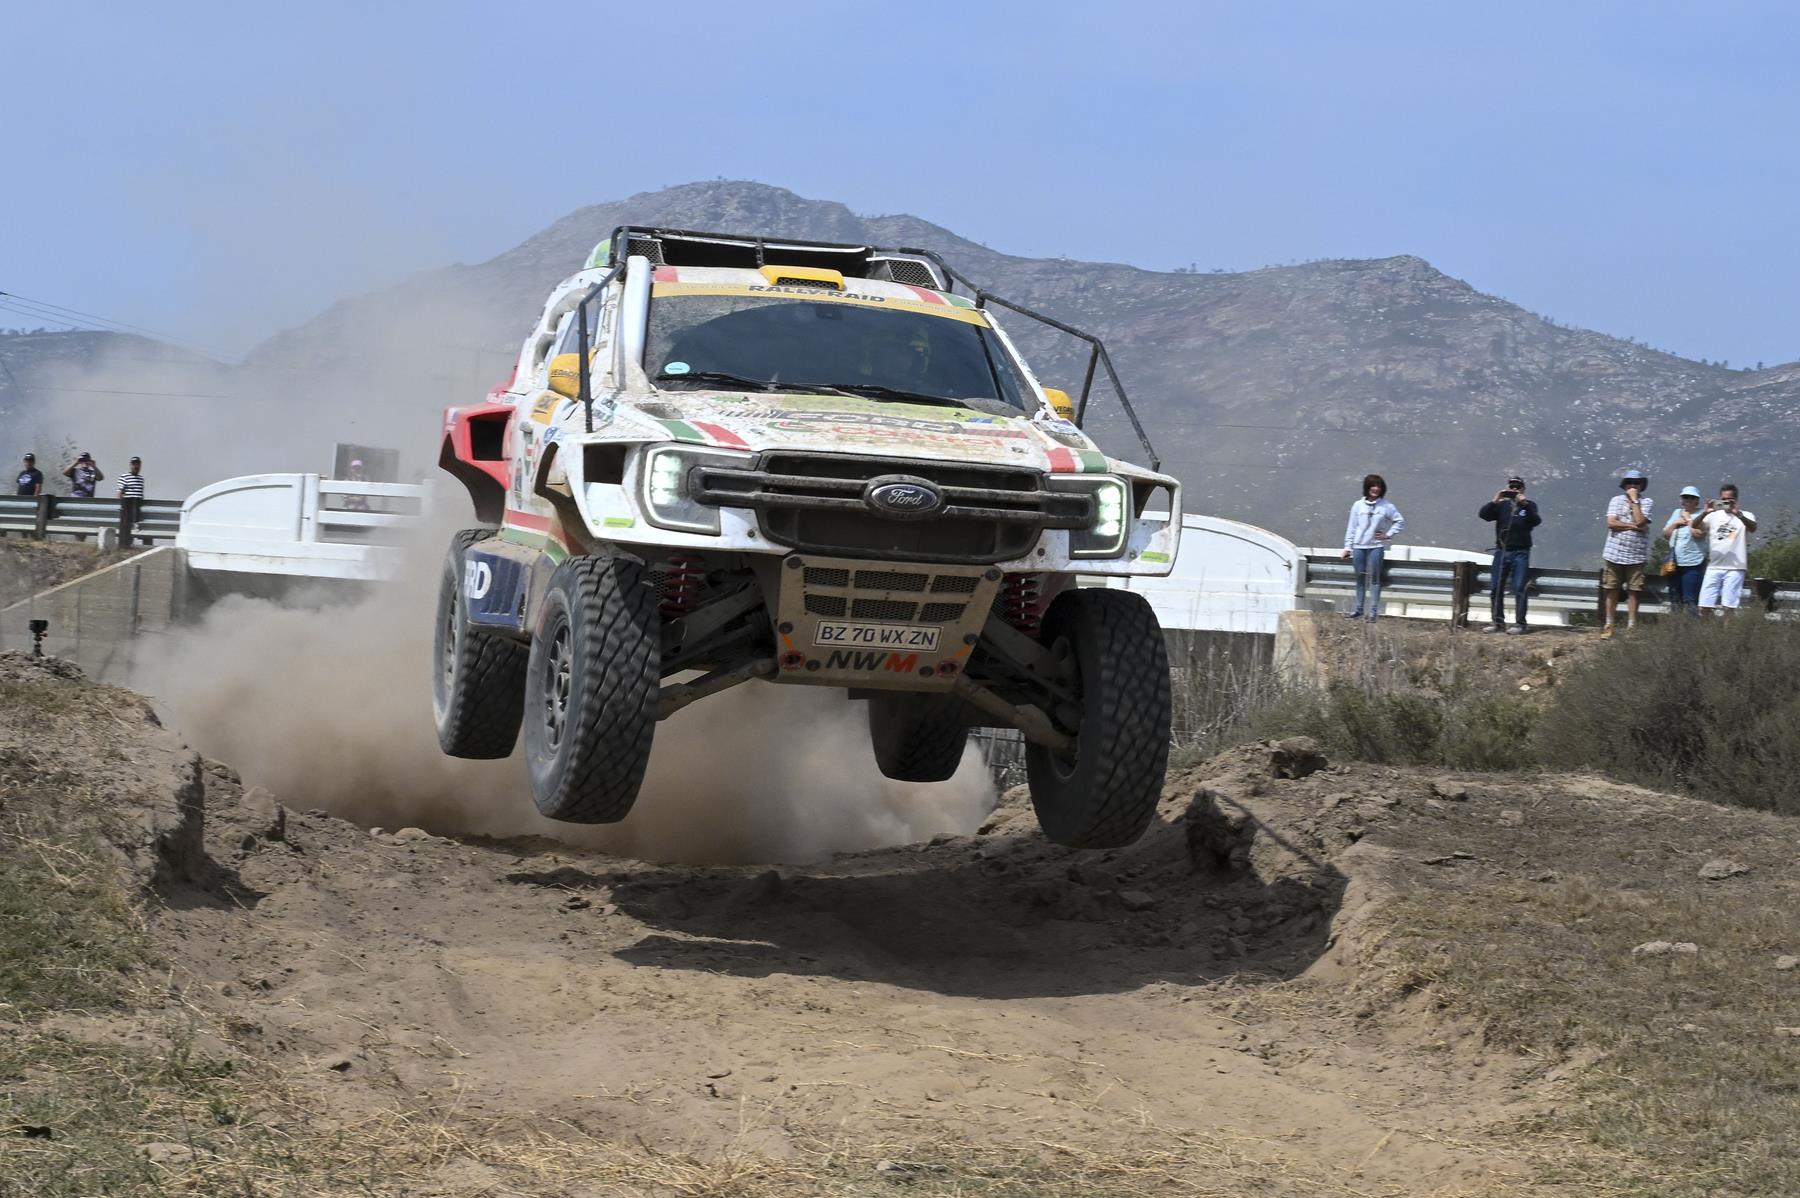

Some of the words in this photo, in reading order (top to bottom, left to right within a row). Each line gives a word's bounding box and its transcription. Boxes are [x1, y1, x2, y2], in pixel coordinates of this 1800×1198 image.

[749, 285, 886, 302] RALLY-RAID
[786, 413, 955, 432] FORD
[832, 425, 1004, 447] Castrol
[887, 488, 924, 505] Ford
[821, 626, 849, 641] BZ
[852, 627, 876, 642] 70
[880, 629, 908, 644] WX
[908, 631, 936, 646] ZN
[826, 650, 919, 673] NWM
